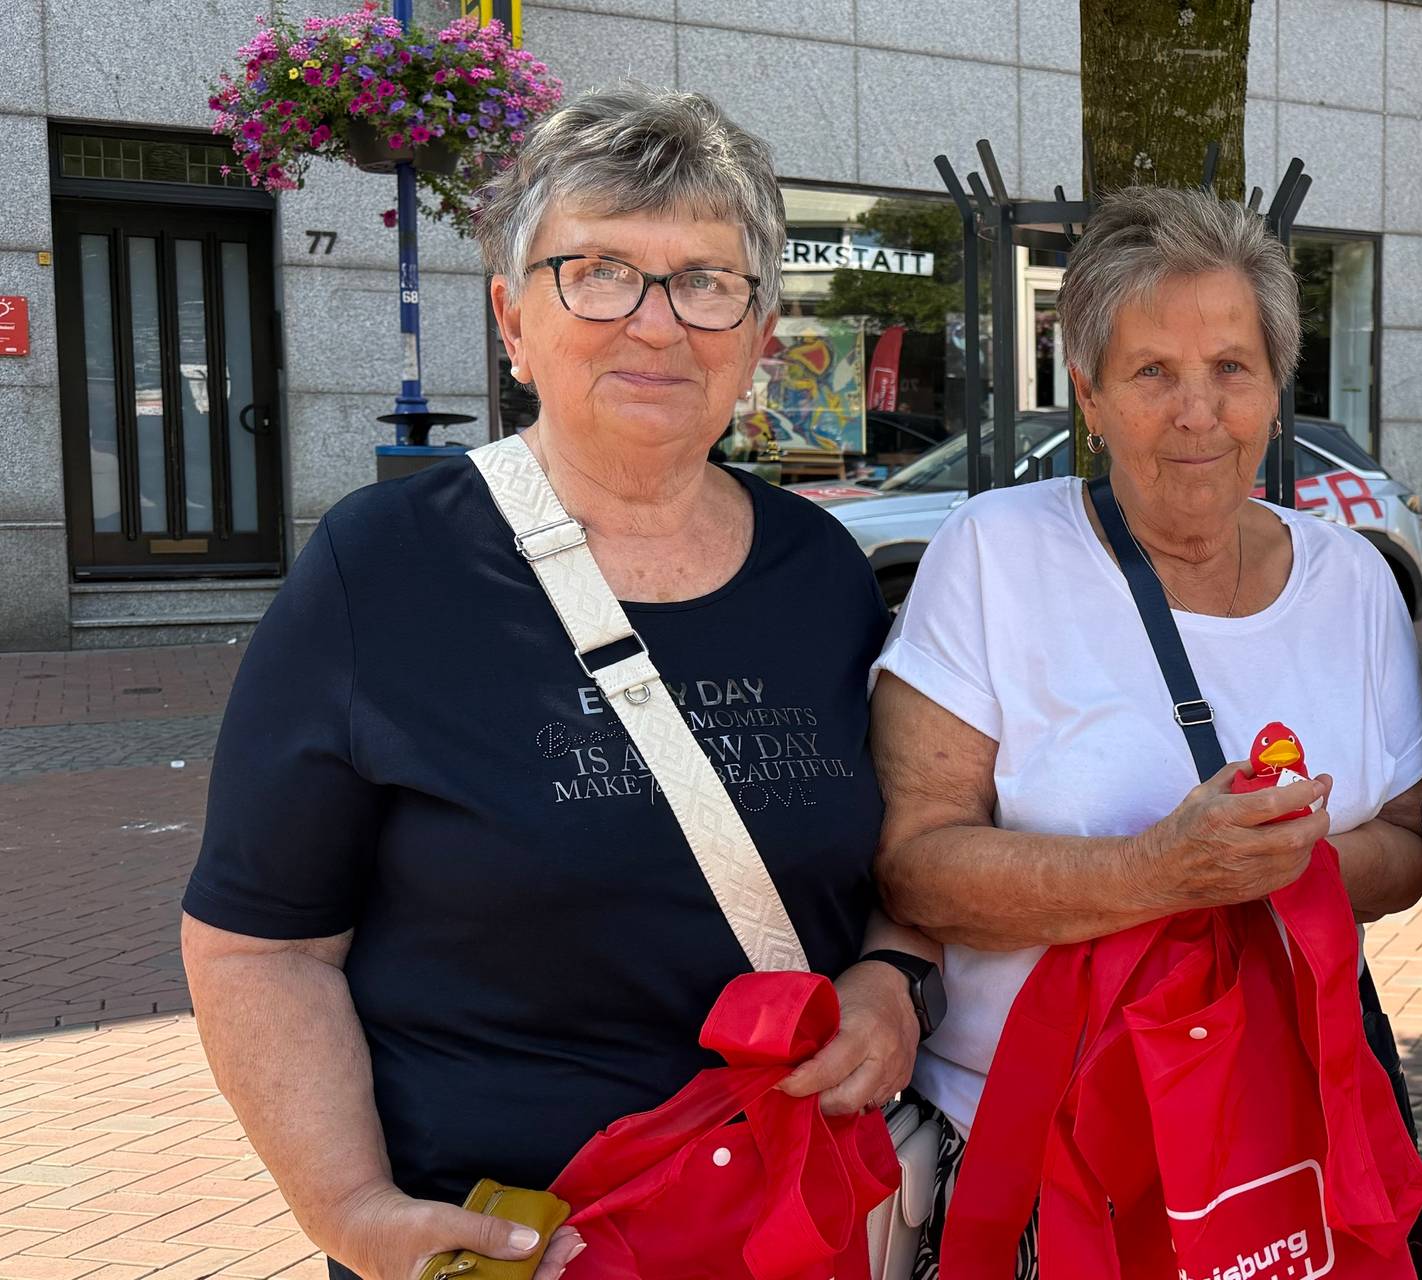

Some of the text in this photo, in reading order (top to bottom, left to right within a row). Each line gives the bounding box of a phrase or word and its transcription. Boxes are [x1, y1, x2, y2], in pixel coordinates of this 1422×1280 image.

[305, 230, 337, 254] 77
[782, 242, 925, 274] ERKSTATT
[402, 291, 418, 304] 68
[1295, 471, 1384, 526] ER
[696, 678, 764, 706] DAY
[687, 707, 817, 732] MOMENTS
[570, 746, 610, 776] IS
[621, 743, 650, 772] A
[751, 732, 821, 760] DAY
[552, 774, 641, 803] MAKE
